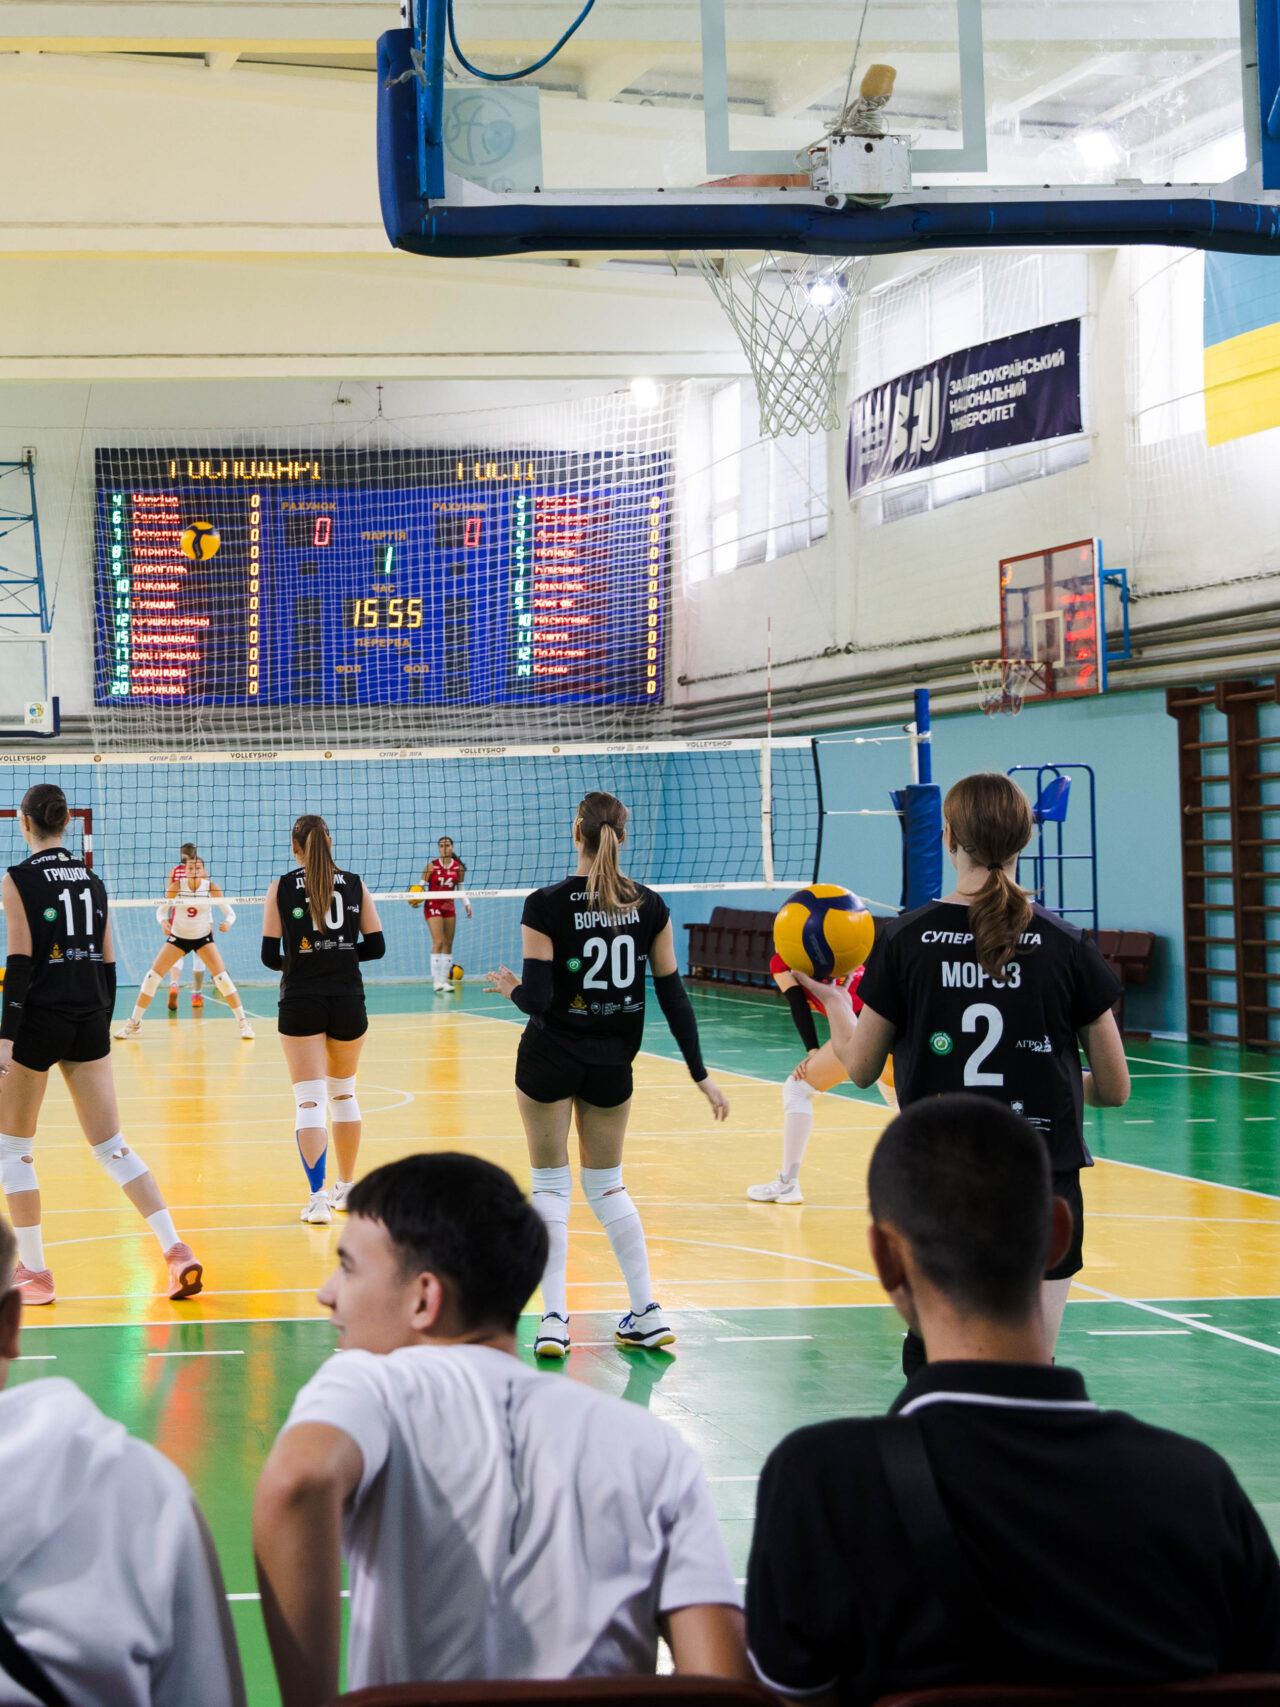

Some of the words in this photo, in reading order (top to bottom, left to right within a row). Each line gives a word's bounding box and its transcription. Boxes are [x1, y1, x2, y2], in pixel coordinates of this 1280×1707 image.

[112, 494, 122, 506] 4
[251, 494, 260, 508] 0
[281, 501, 337, 511] РАХУНОК
[432, 502, 487, 512] РАХУНОК
[516, 495, 526, 509] 2
[112, 511, 122, 524] 6
[250, 511, 260, 525] 0
[516, 512, 525, 526] 3
[114, 528, 122, 541] 7
[250, 528, 260, 542] 0
[313, 517, 332, 546] 0
[361, 531, 407, 541] ПАРТІЯ
[463, 517, 482, 547] 0
[516, 529, 525, 541] 4
[112, 545, 122, 559] 8
[250, 545, 260, 559] 0
[515, 546, 525, 560] 5
[384, 546, 394, 574] 1
[112, 562, 122, 576] 9
[249, 562, 259, 576] 0
[517, 563, 525, 575] 7
[116, 579, 130, 593] 10
[249, 579, 259, 593] 0
[371, 584, 396, 593] ЧАС
[514, 580, 524, 593] 8
[116, 597, 129, 609] 11
[249, 596, 259, 610] 0
[514, 597, 524, 610] 9
[116, 613, 129, 627] 12
[249, 613, 258, 627] 0
[518, 613, 531, 627] 10
[116, 630, 129, 644] 15
[249, 630, 258, 644] 0
[354, 638, 410, 648] ПЕРЕРВА
[518, 631, 531, 643] 11
[116, 648, 129, 660] 17
[249, 647, 258, 661] 0
[518, 647, 531, 660] 12
[249, 664, 258, 678] 0
[335, 664, 362, 674] ФОЛ
[403, 664, 429, 674] ФОЛ
[517, 664, 530, 676] 14
[111, 681, 129, 695] 20
[249, 681, 258, 695] 0
[459, 747, 506, 755] VOLLEYSHOP
[685, 740, 732, 748] VOLLEYSHOP
[230, 752, 278, 760] VOLLEYSHOP
[31, 854, 57, 865] СУПЕР
[43, 867, 91, 882] ГРИЦЮК
[437, 876, 454, 887] 14
[58, 887, 94, 936] 11
[186, 906, 198, 918] 9
[921, 930, 974, 945] СУПЕР
[582, 933, 636, 991] 20
[961, 1002, 1004, 1087] 2
